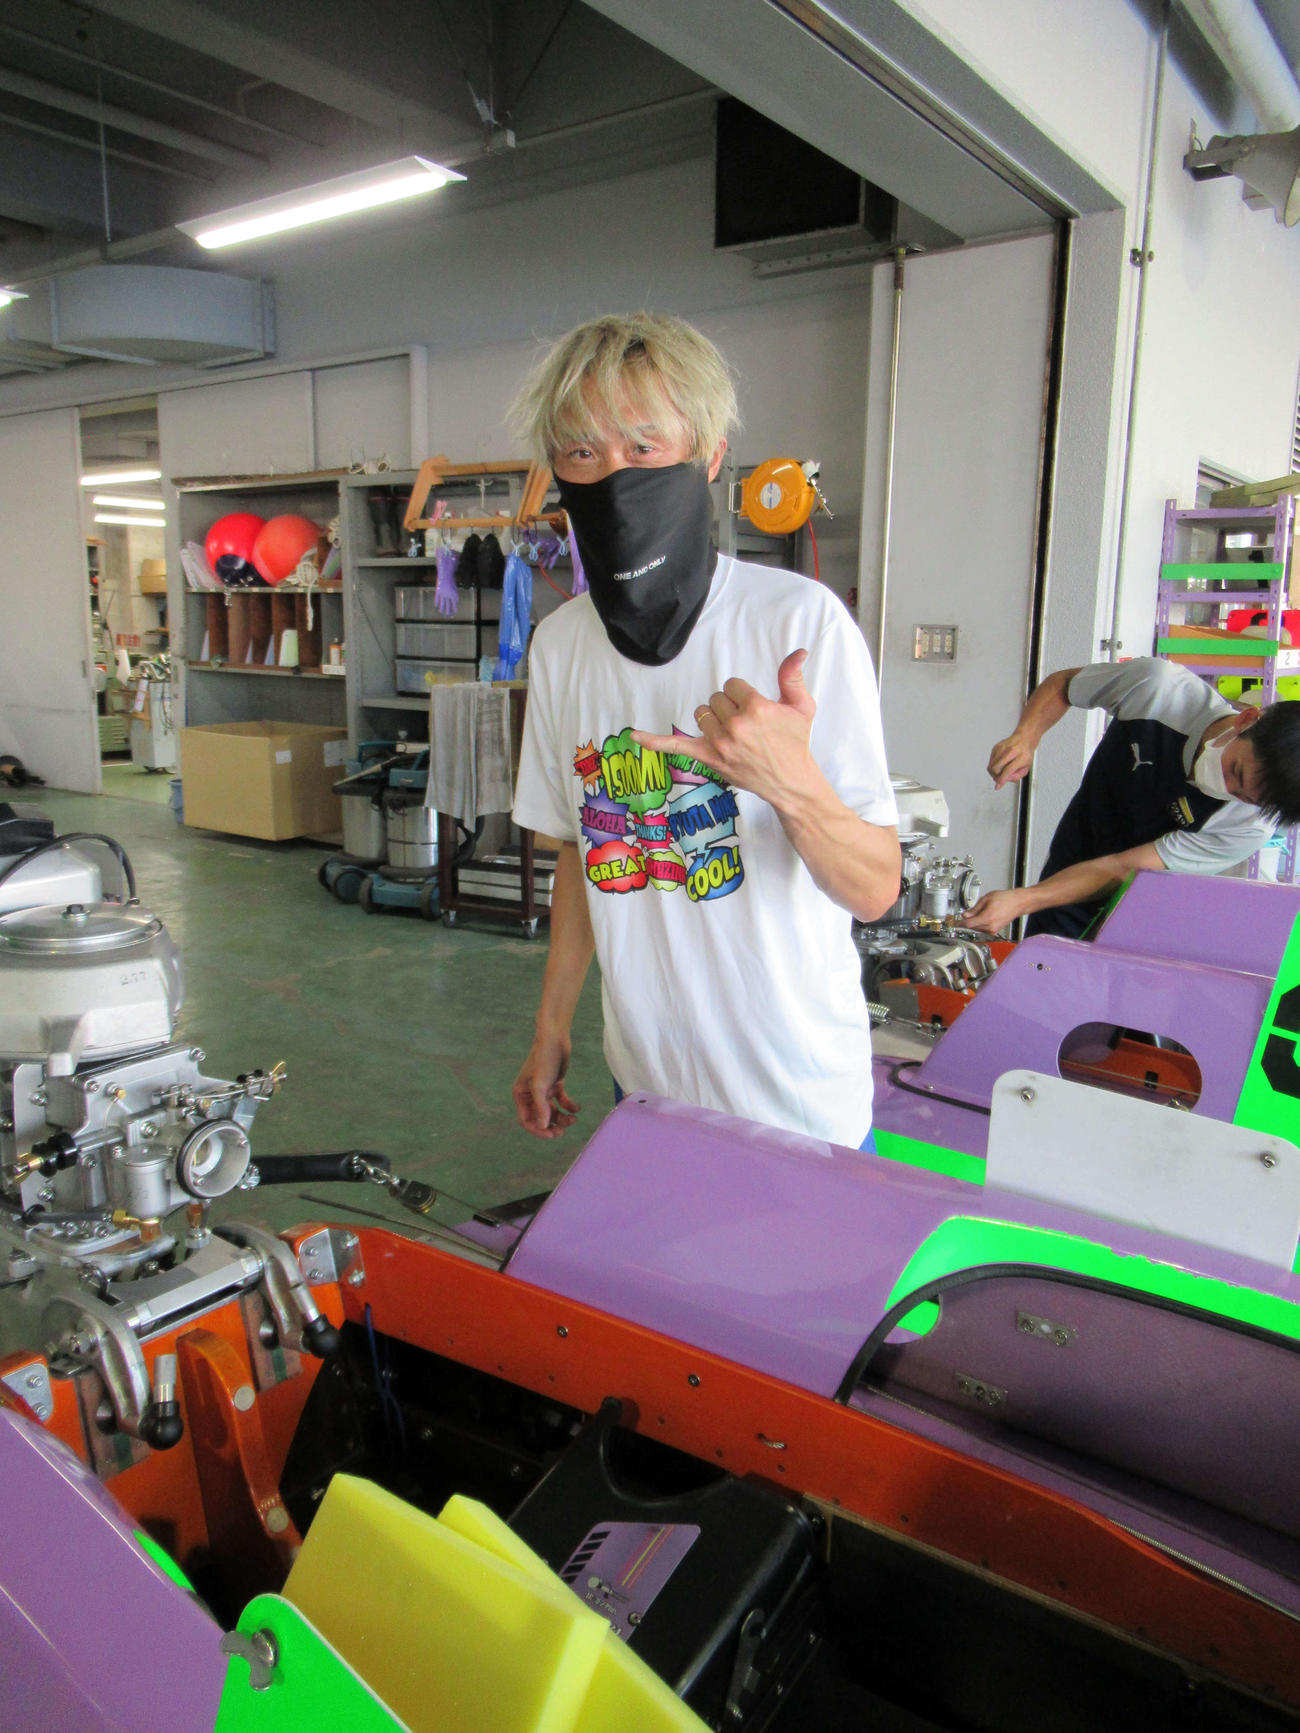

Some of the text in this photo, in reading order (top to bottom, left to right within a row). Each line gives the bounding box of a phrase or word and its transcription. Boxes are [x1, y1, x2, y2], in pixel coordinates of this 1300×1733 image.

[613, 555, 666, 581] ONE AND ONLY
[580, 806, 628, 835] ALOHA
[588, 853, 647, 883] GREAT
[686, 844, 741, 902] COOL!
